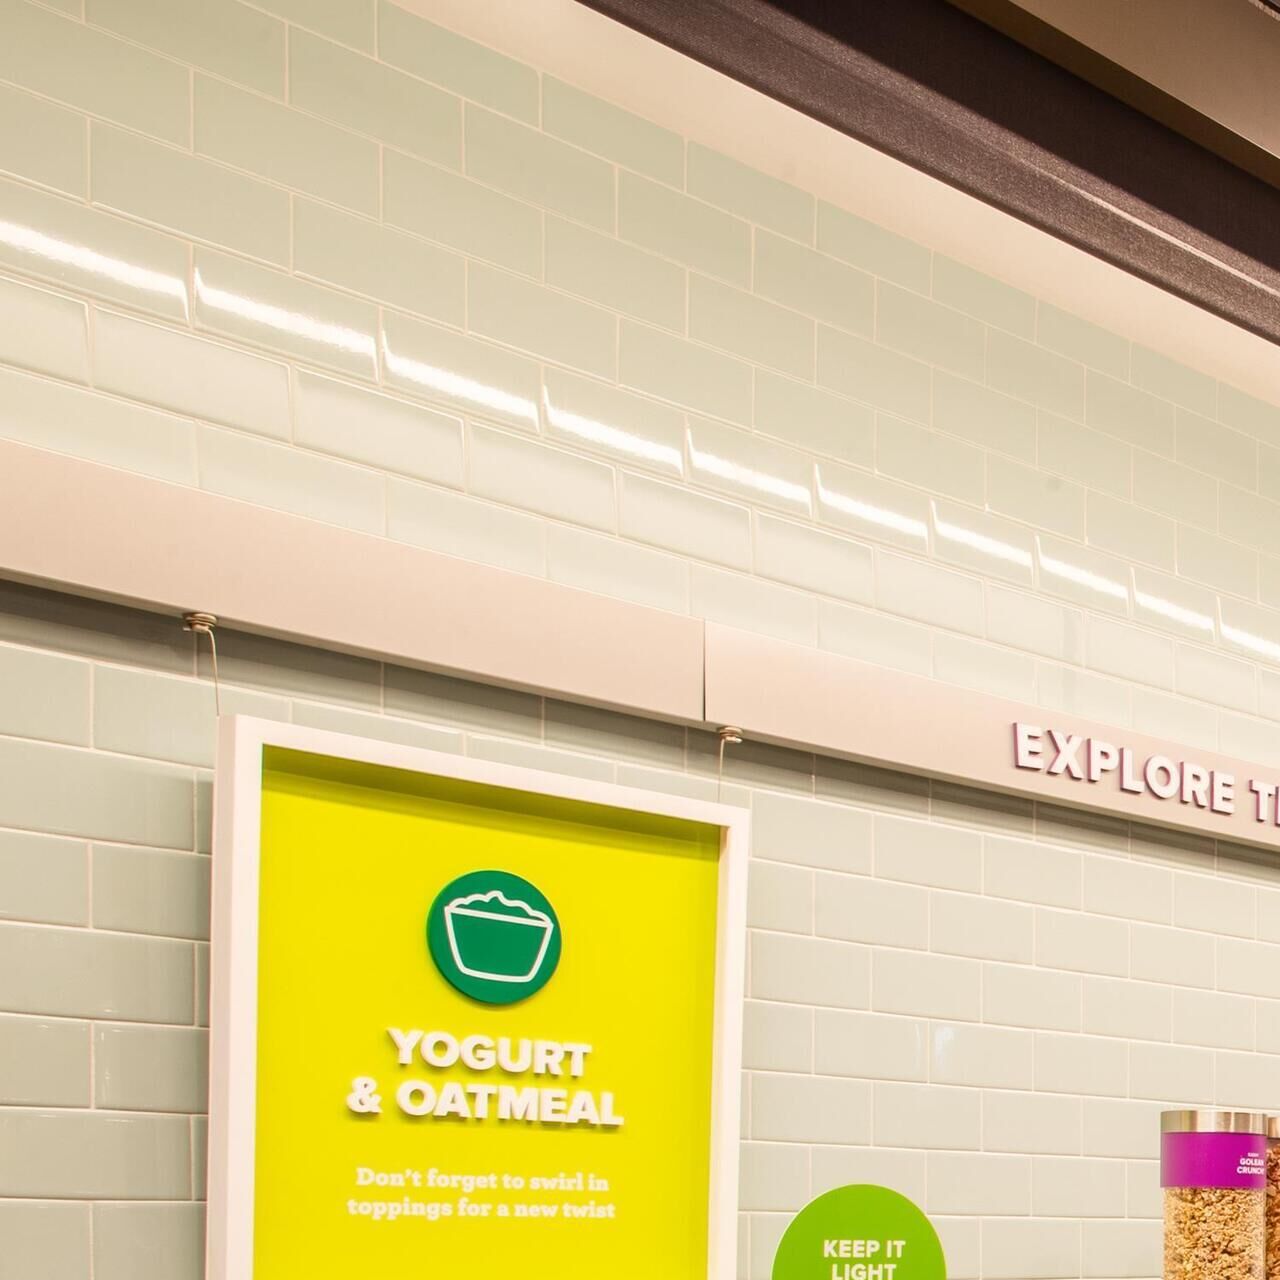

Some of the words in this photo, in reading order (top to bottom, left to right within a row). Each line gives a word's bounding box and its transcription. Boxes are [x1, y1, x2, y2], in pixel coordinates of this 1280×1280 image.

[1013, 721, 1235, 815] EXPLORE
[387, 1027, 592, 1077] YOGURT
[346, 1076, 383, 1114] &
[395, 1079, 624, 1126] OATMEAL
[355, 1167, 421, 1187] Don't
[426, 1169, 498, 1192] forget
[502, 1173, 525, 1190] to
[529, 1172, 583, 1192] swirl
[588, 1173, 609, 1192] in
[347, 1197, 453, 1221] toppings
[457, 1198, 491, 1217] for
[496, 1203, 509, 1217] a
[514, 1203, 559, 1218] new
[563, 1201, 616, 1219] twist
[823, 1239, 880, 1258] KEEP
[886, 1239, 906, 1258] IT
